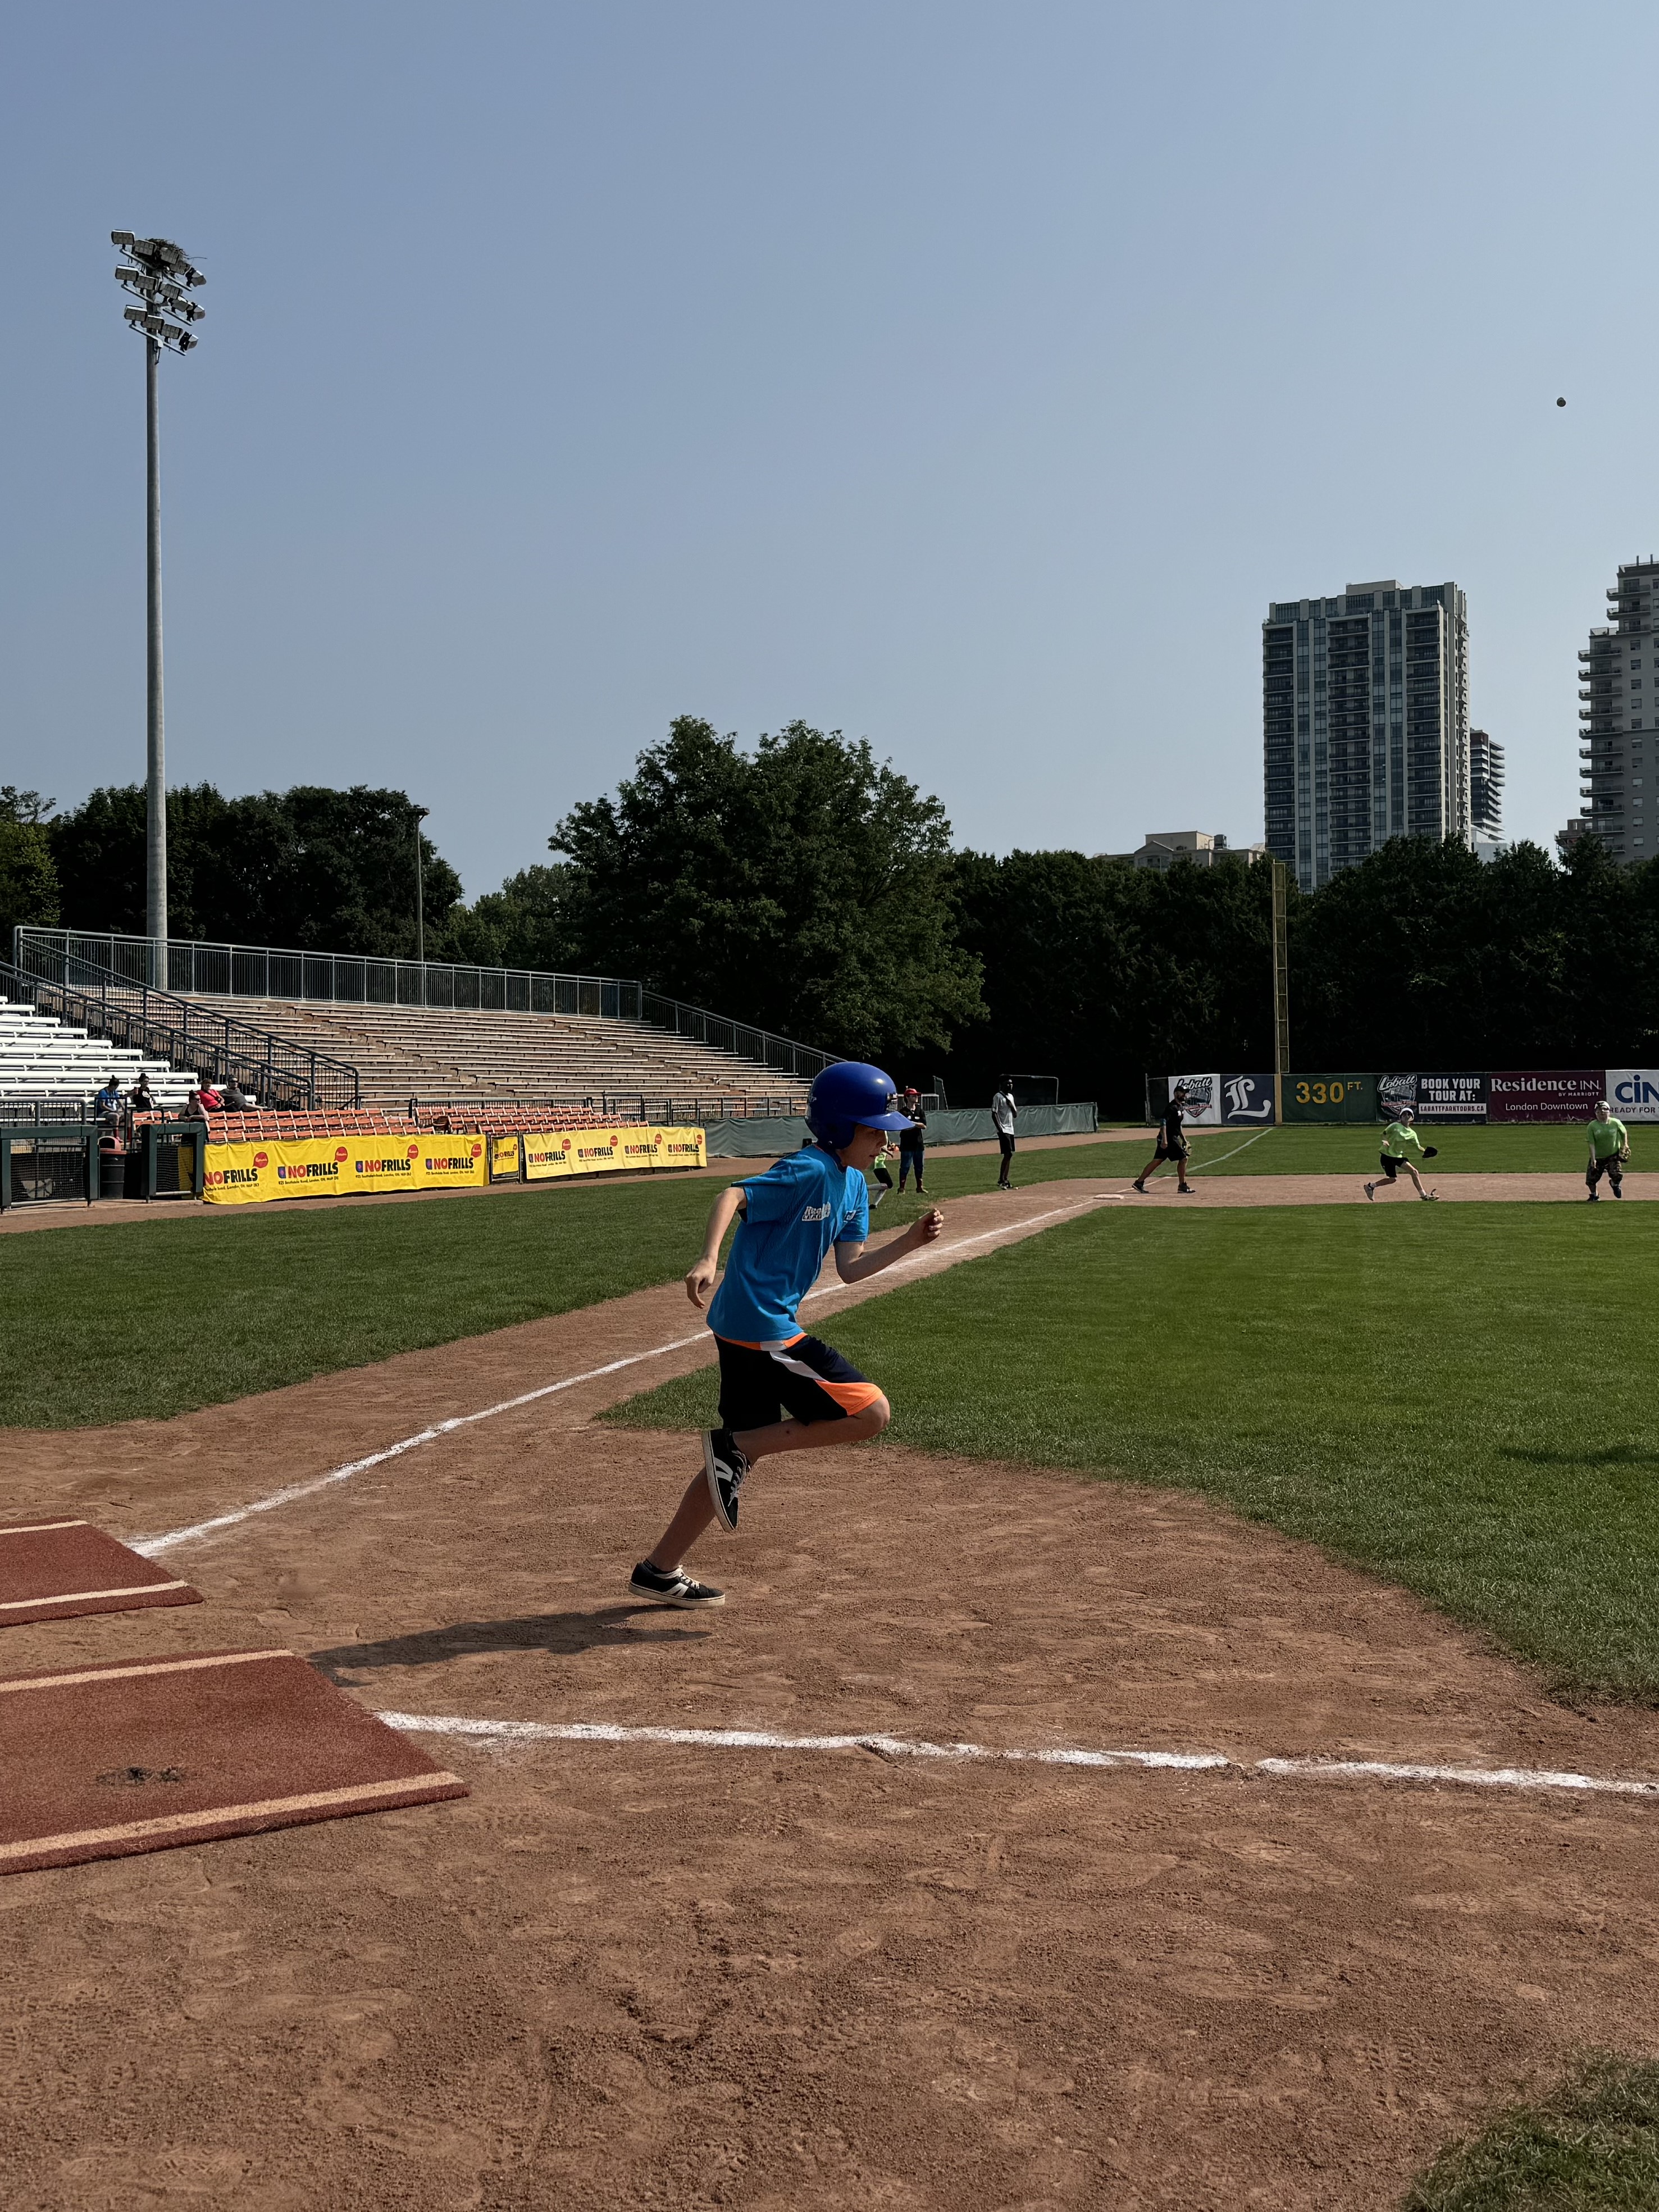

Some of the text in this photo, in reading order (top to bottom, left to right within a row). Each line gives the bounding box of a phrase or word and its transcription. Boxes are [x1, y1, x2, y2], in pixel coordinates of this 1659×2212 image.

[1421, 1078, 1480, 1089] BOOK YOUR
[1491, 1077, 1577, 1091] Residence
[1296, 1081, 1363, 1104] 330 FT.
[1429, 1090, 1475, 1101] TOUR AT:
[1506, 1103, 1538, 1111] London
